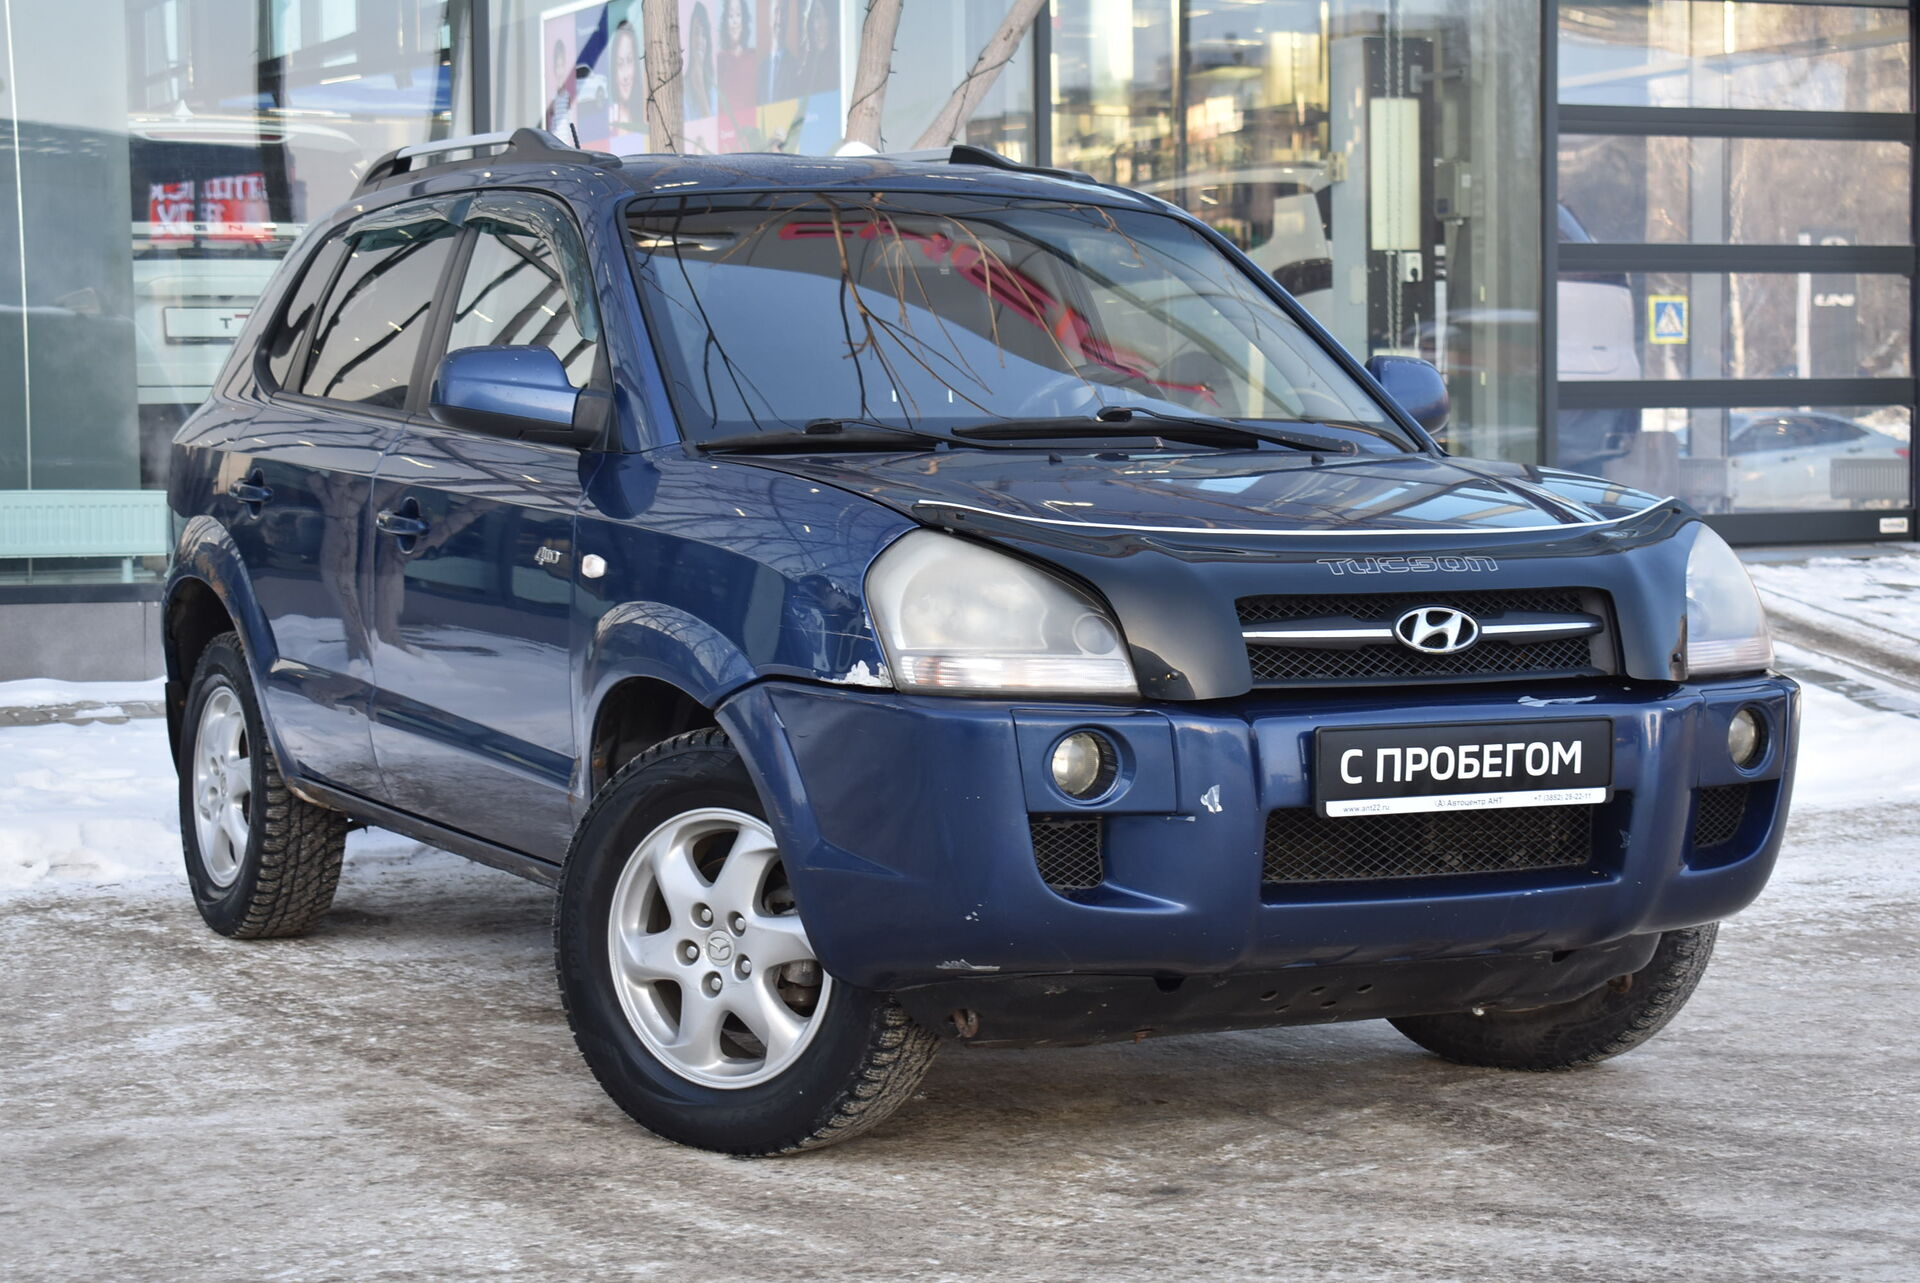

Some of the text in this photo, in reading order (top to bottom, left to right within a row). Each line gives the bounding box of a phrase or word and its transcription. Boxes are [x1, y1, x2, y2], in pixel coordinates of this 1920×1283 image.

[1316, 555, 1499, 575] TUCSON
[1340, 740, 1582, 784] С ПРОБЕГОМ
[1447, 799, 1486, 807] Автоцентр
[1488, 796, 1503, 805] АНТ
